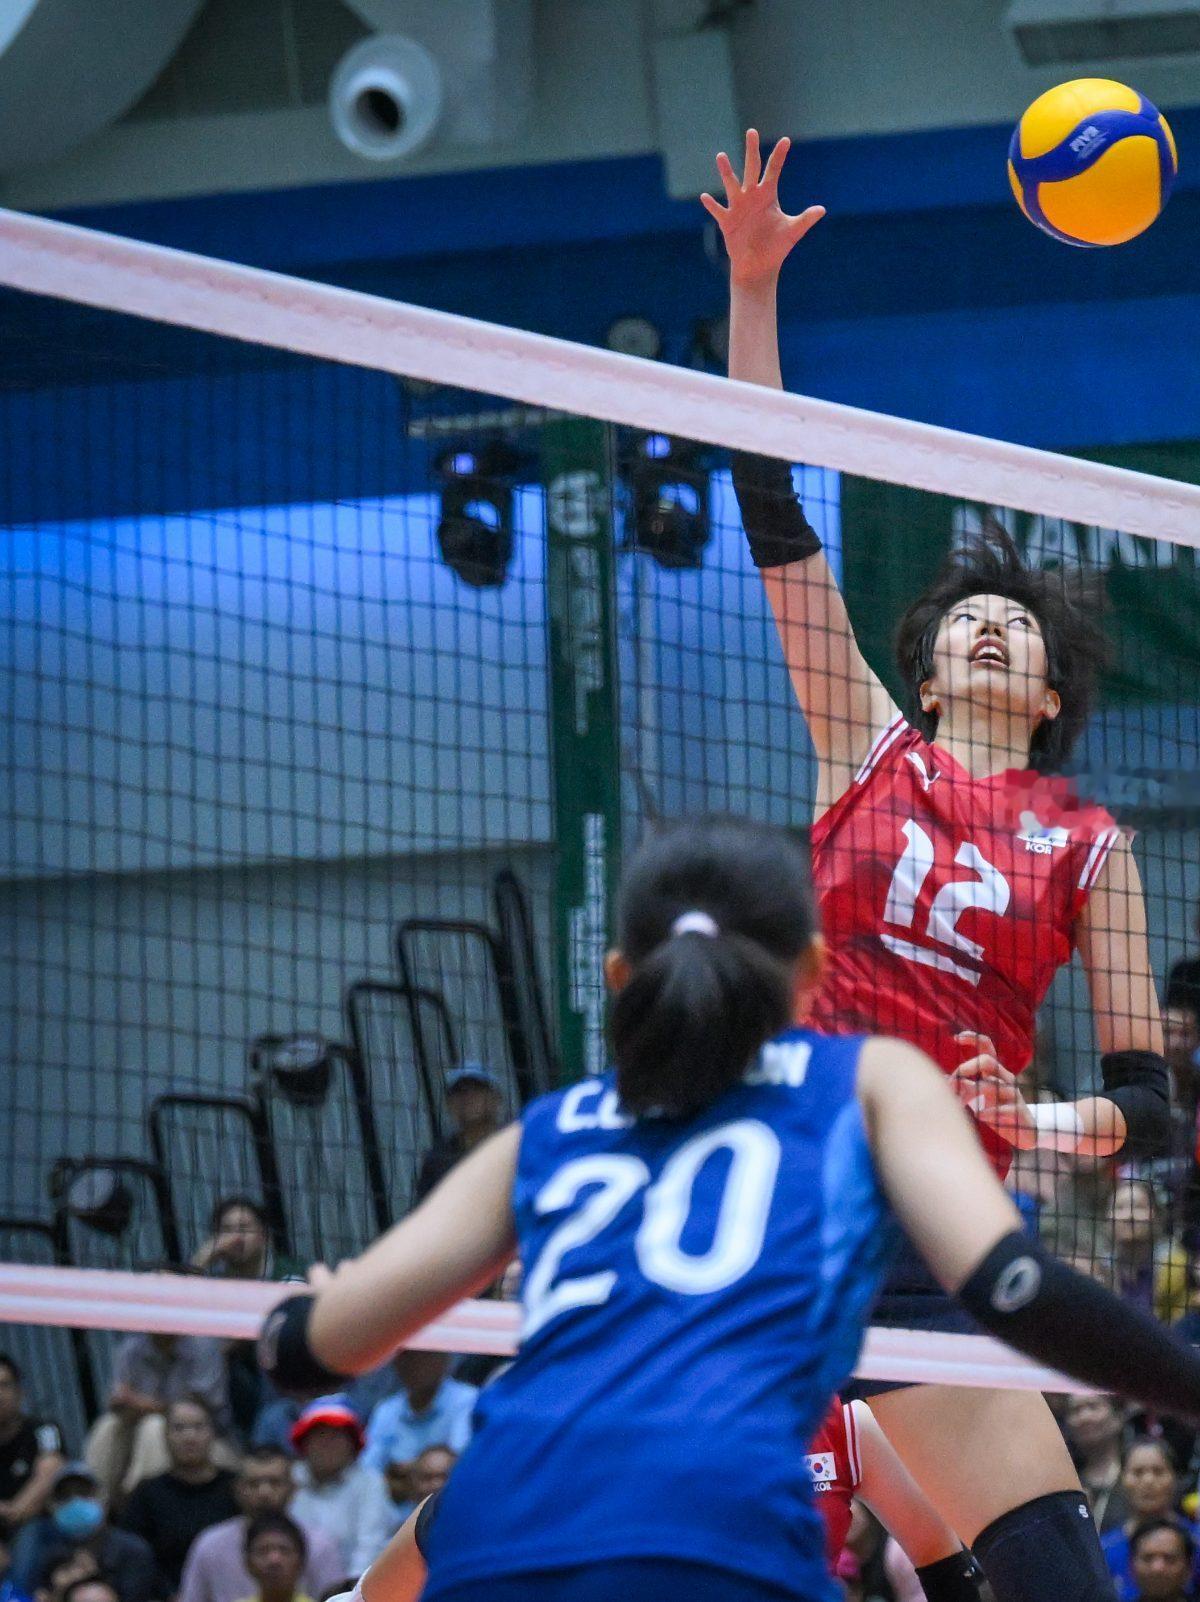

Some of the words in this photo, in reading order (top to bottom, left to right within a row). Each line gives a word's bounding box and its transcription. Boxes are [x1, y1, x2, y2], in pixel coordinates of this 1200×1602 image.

[1025, 841, 1053, 856] KOR
[883, 818, 1011, 962] 12
[519, 1118, 782, 1344] 20
[812, 1480, 833, 1492] KOR
